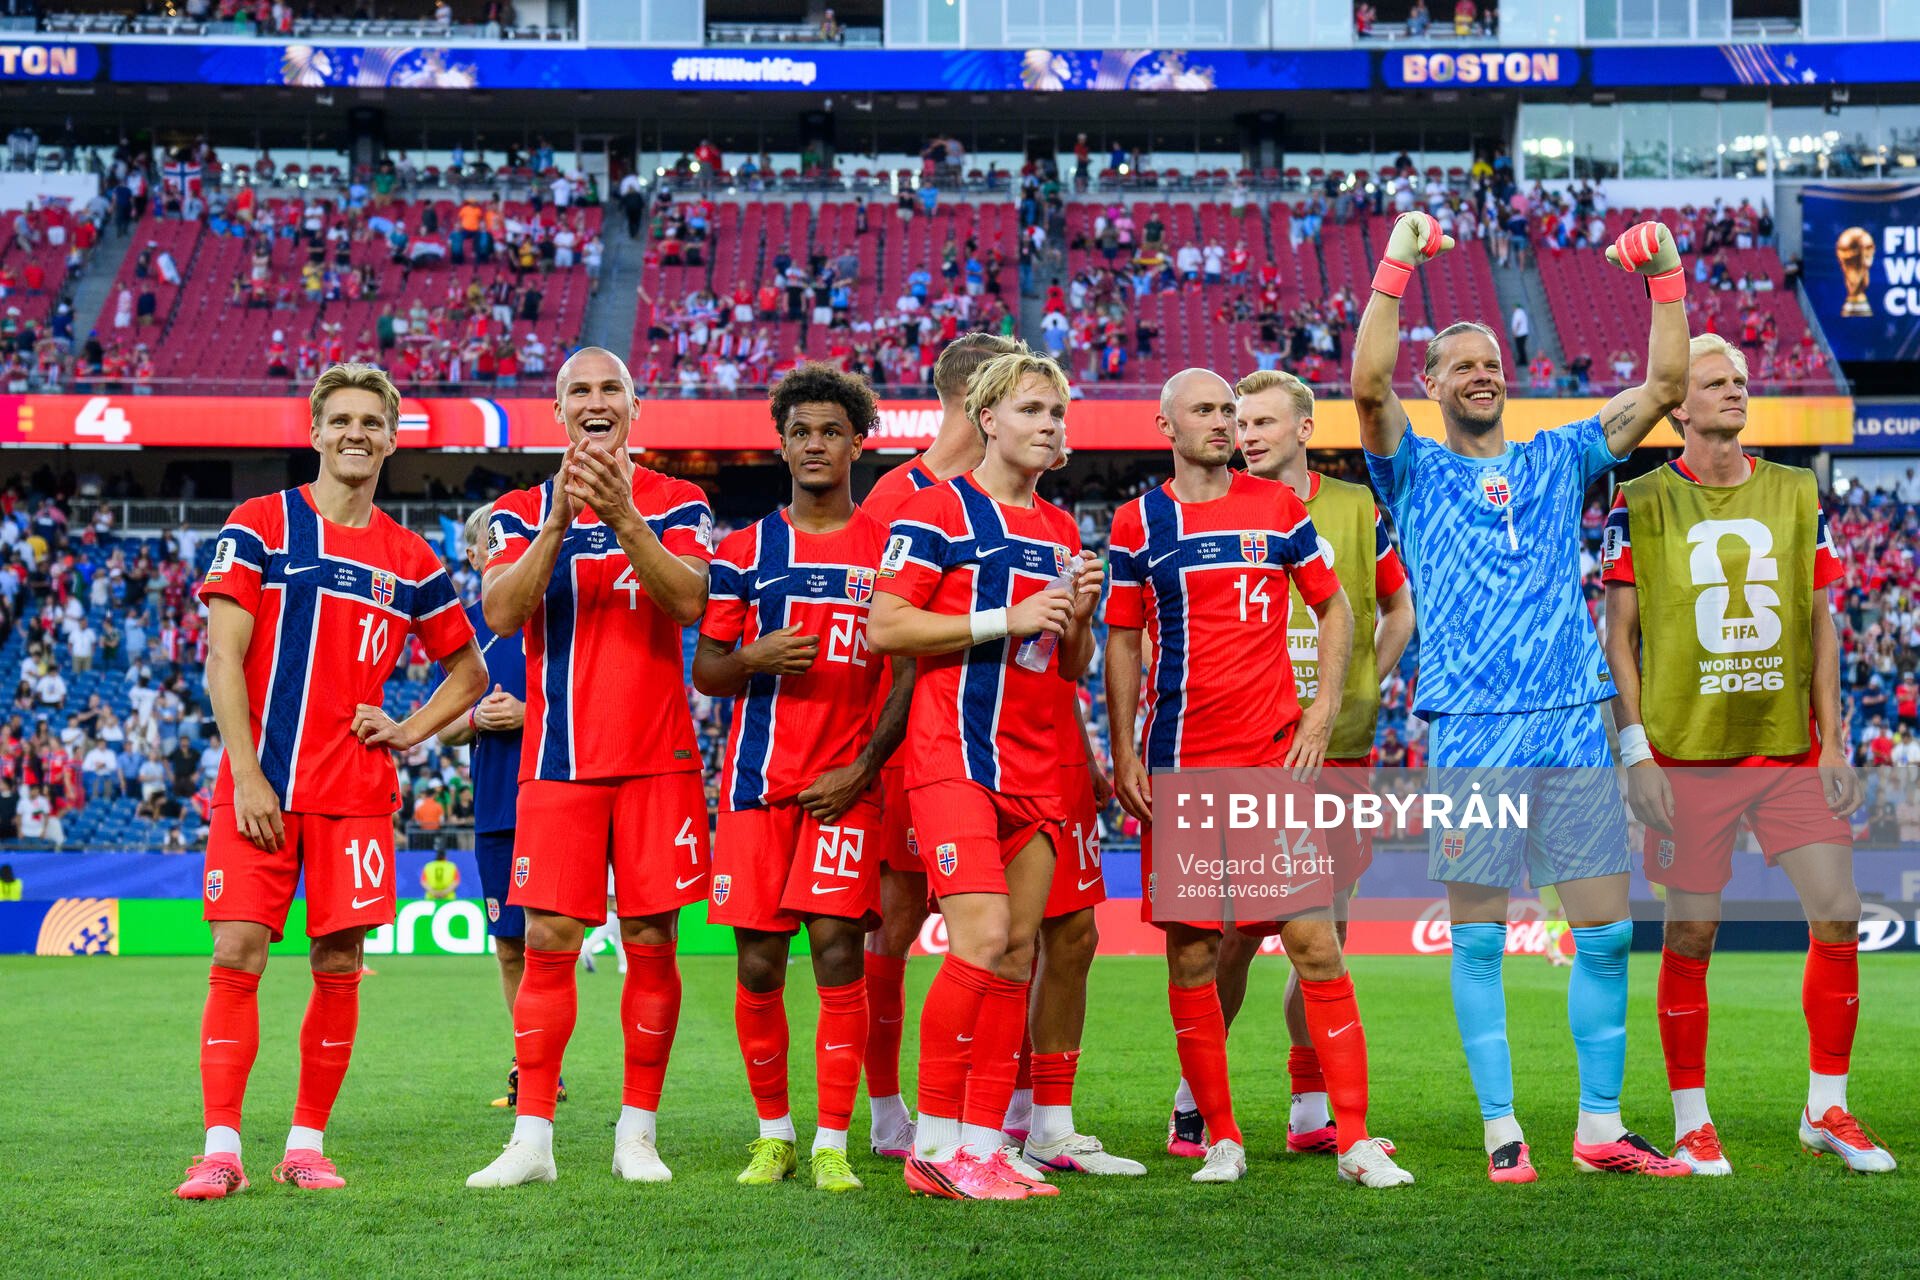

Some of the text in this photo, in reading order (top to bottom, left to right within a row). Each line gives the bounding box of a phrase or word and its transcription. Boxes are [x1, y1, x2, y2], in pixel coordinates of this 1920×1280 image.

[672, 57, 816, 86] #FIFAWorldCup
[1403, 53, 1559, 83] BOSTON
[75, 396, 131, 442] 4
[1501, 507, 1519, 550] 1
[613, 563, 640, 610] 4
[1233, 574, 1271, 623] 14
[357, 613, 388, 666] 10
[1721, 624, 1759, 640] FIFA
[1699, 656, 1784, 672] WORLD CUP
[1700, 671, 1785, 695] 2026
[674, 816, 698, 865] 4
[813, 824, 865, 879] 22
[345, 839, 385, 889] 10
